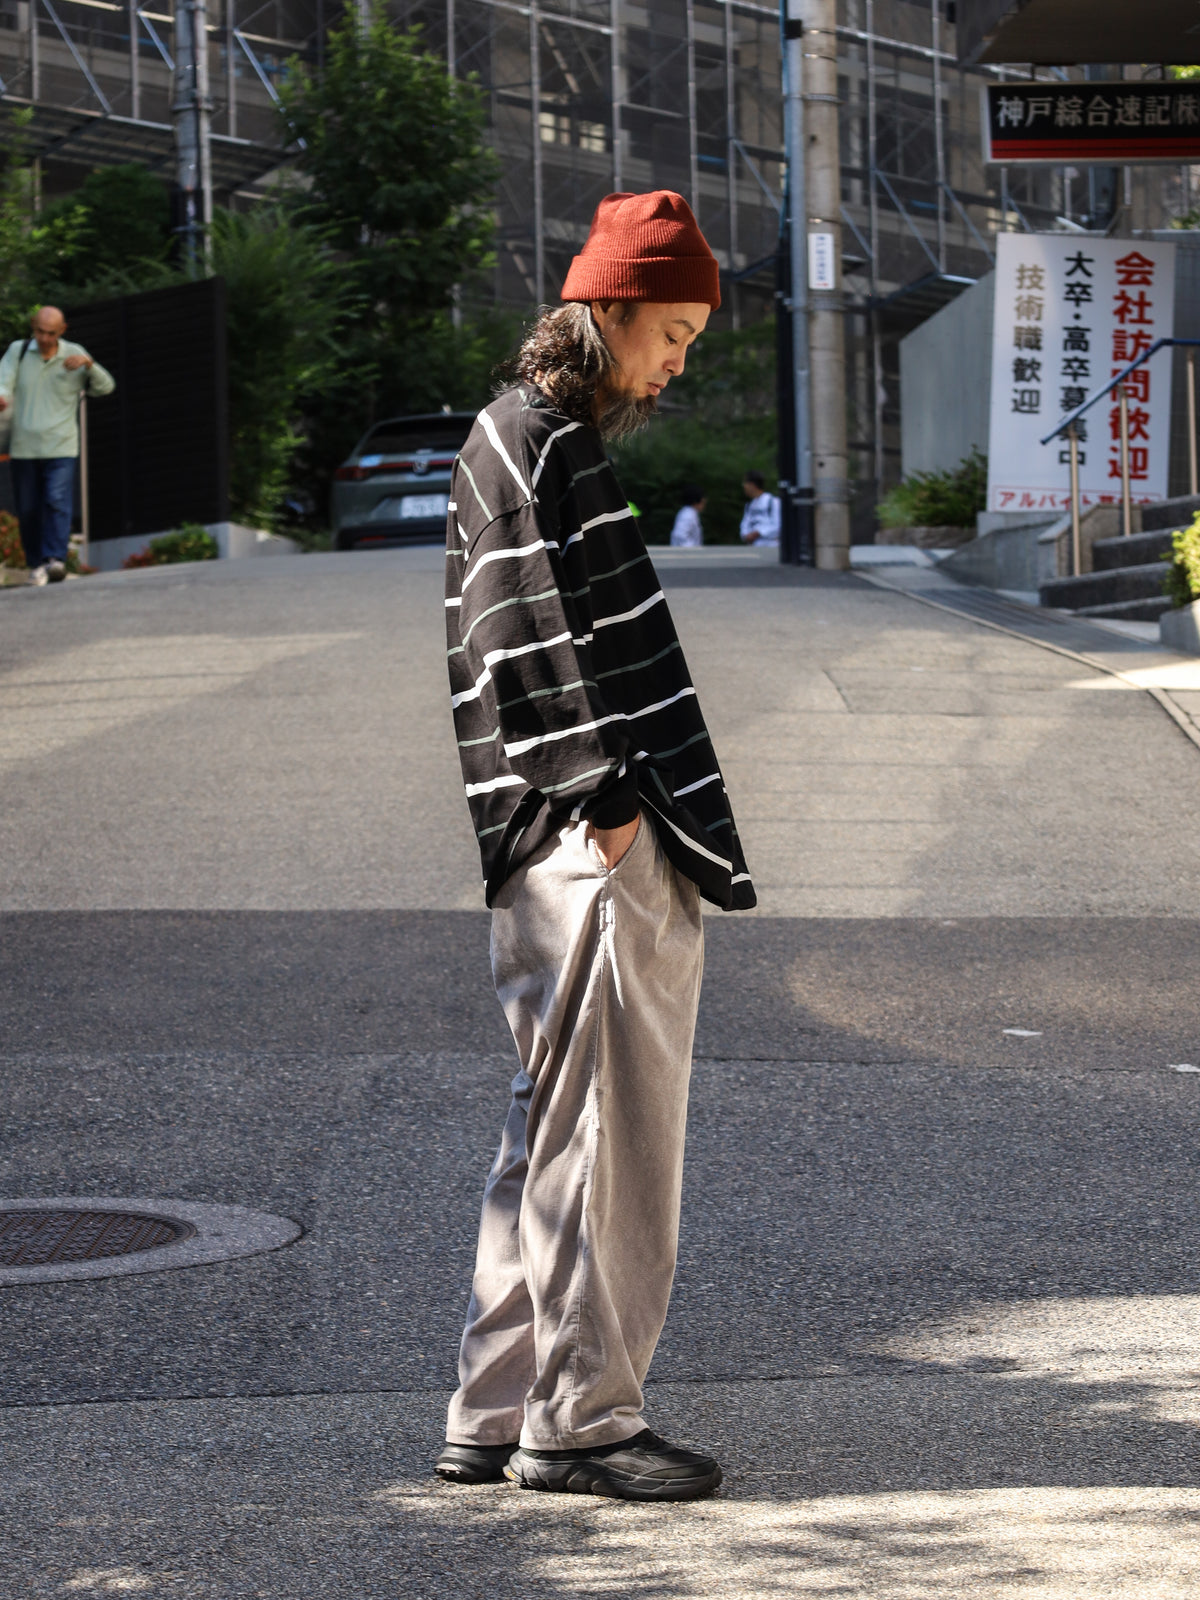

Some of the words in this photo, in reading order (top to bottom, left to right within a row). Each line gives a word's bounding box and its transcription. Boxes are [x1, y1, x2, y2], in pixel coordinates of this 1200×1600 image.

[1011, 263, 1045, 415] 技術職歓迎
[1107, 251, 1155, 481] 会社訪問歓迎
